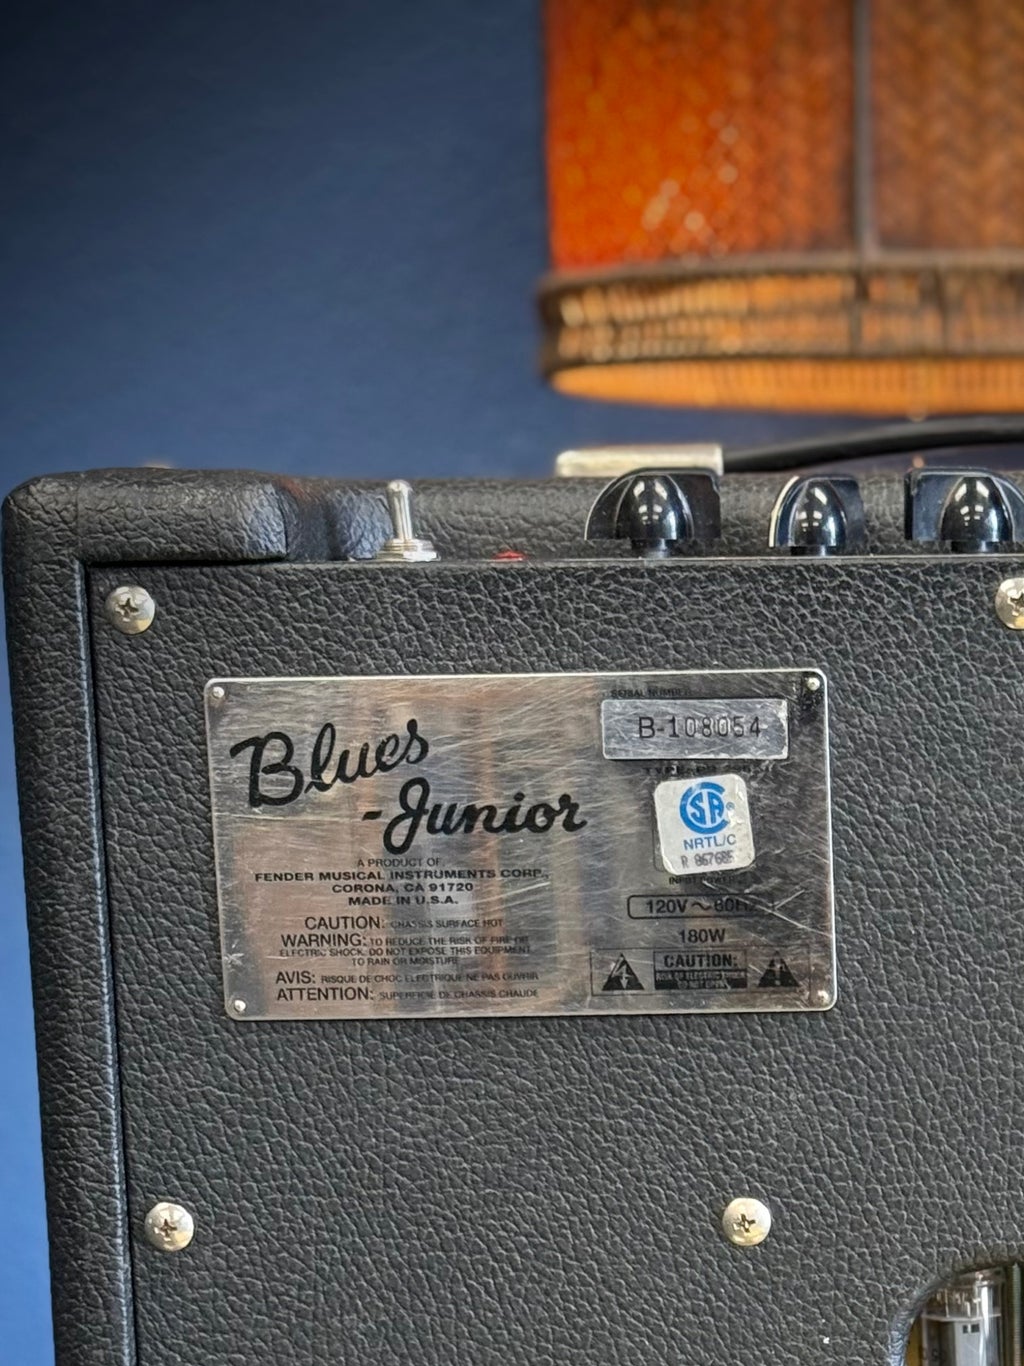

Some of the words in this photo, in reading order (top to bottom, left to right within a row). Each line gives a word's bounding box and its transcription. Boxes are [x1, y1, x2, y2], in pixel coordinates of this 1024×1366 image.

[638, 715, 762, 739] B-108054
[230, 718, 429, 807] Blues
[683, 834, 737, 850] NRTL/C
[357, 859, 365, 867] A
[368, 858, 423, 868] PRODUCT
[255, 872, 314, 882] FENDER
[319, 871, 385, 881] MUSICAL
[390, 869, 497, 880] INSTRUMENTS
[332, 884, 399, 894] CORONA,
[404, 883, 425, 892] CA
[428, 882, 474, 892] 91720
[348, 897, 391, 906] MADE
[396, 896, 411, 905] IN
[415, 895, 459, 905] U.S.A.
[646, 899, 688, 914] 120V
[304, 915, 386, 931] CAUTION:
[281, 933, 367, 947] WARNING:
[370, 938, 383, 947] TO
[680, 929, 726, 944] 180W
[368, 947, 384, 956] DO
[386, 947, 406, 956] NOT
[408, 946, 447, 956] EXPOSE
[450, 946, 472, 955] THIS
[352, 957, 365, 967] TO
[367, 957, 390, 966] RAIN
[663, 954, 737, 968] CAUTION:
[275, 970, 316, 985] AVIS:
[321, 975, 357, 984] RISQUE
[358, 974, 372, 983] DE
[277, 986, 375, 1001] ATTENTION:
